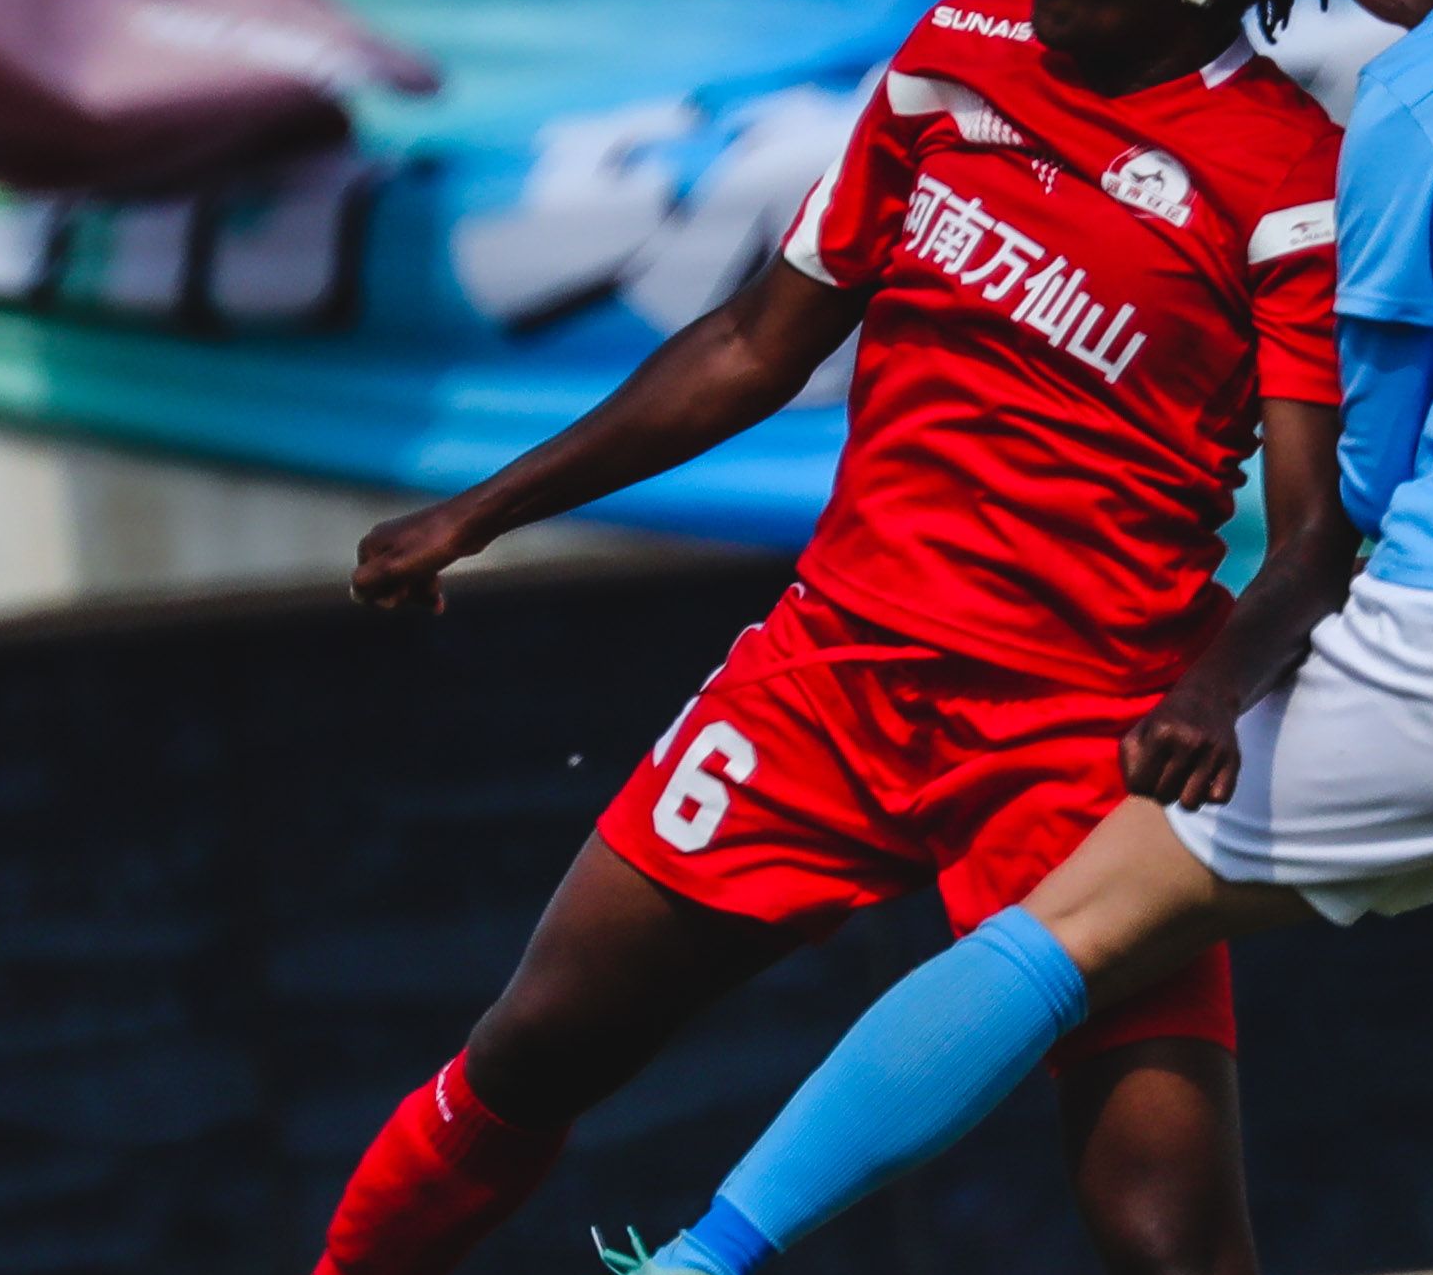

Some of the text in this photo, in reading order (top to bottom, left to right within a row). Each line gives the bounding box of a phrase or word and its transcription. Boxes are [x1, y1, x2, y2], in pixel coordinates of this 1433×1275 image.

[932, 6, 1035, 42] SUNAIS
[903, 173, 1148, 384] 河南万仙山
[652, 720, 758, 853] 6
